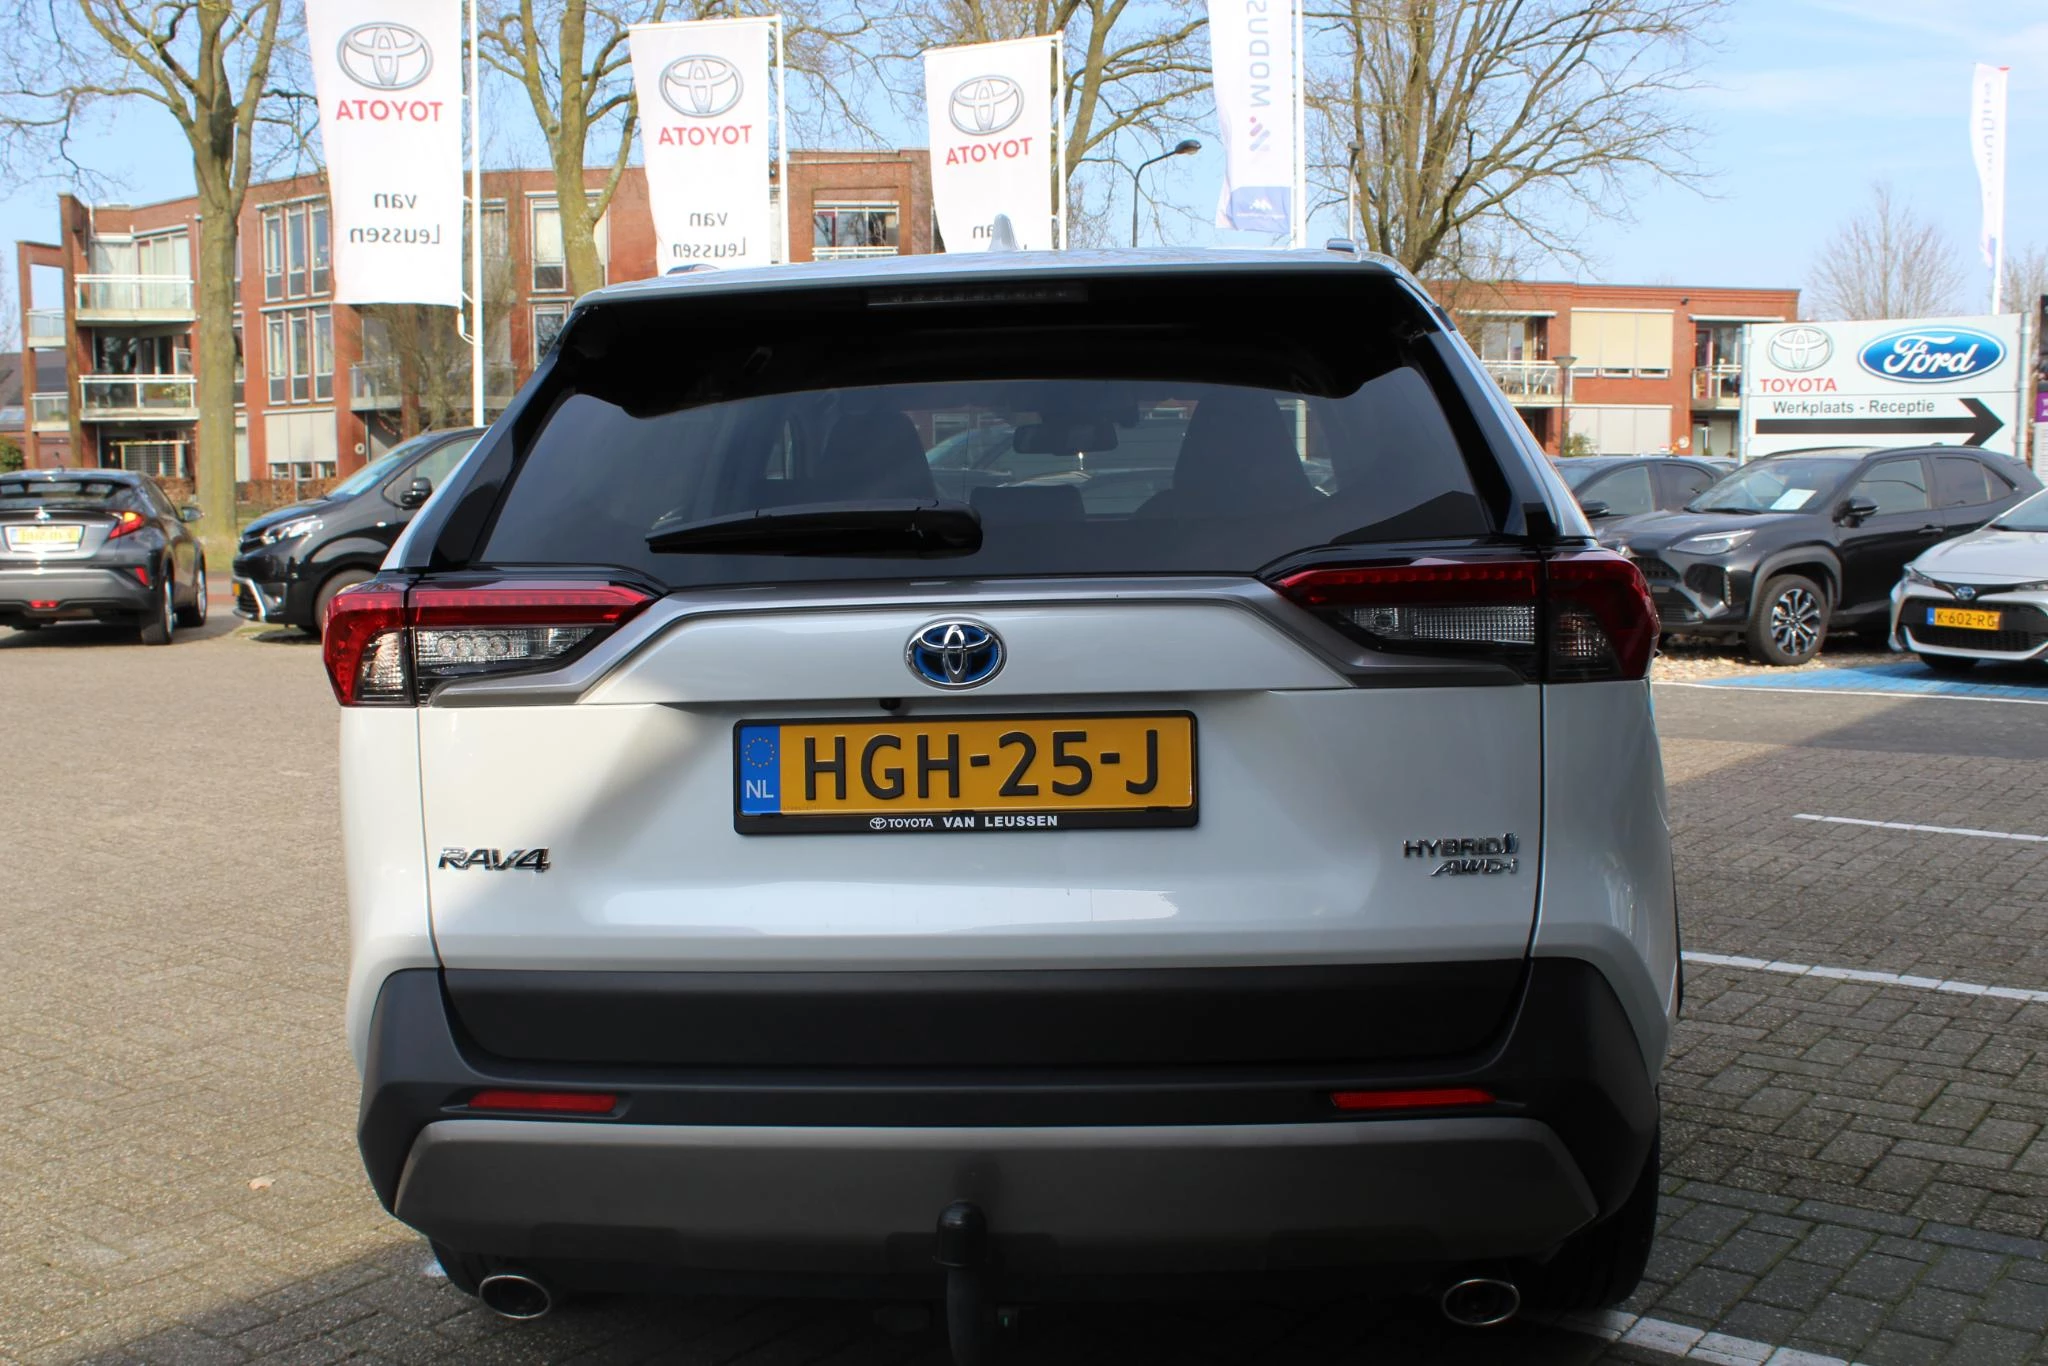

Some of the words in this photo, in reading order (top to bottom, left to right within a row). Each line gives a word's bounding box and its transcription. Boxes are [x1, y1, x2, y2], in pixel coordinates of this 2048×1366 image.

[1883, 334, 1980, 375] Ford
[1760, 377, 1837, 393] TOYOTA
[1773, 400, 1855, 415] Werkplaats
[1869, 399, 1935, 415] Receptie
[1936, 610, 1997, 627] K-602-RG
[803, 729, 1159, 801] HGH-25-J
[745, 779, 775, 799] NL
[887, 817, 934, 829] TOYOTA
[943, 816, 976, 828] VAN
[984, 815, 1058, 828] LEUSSEN
[438, 847, 552, 873] RAV4
